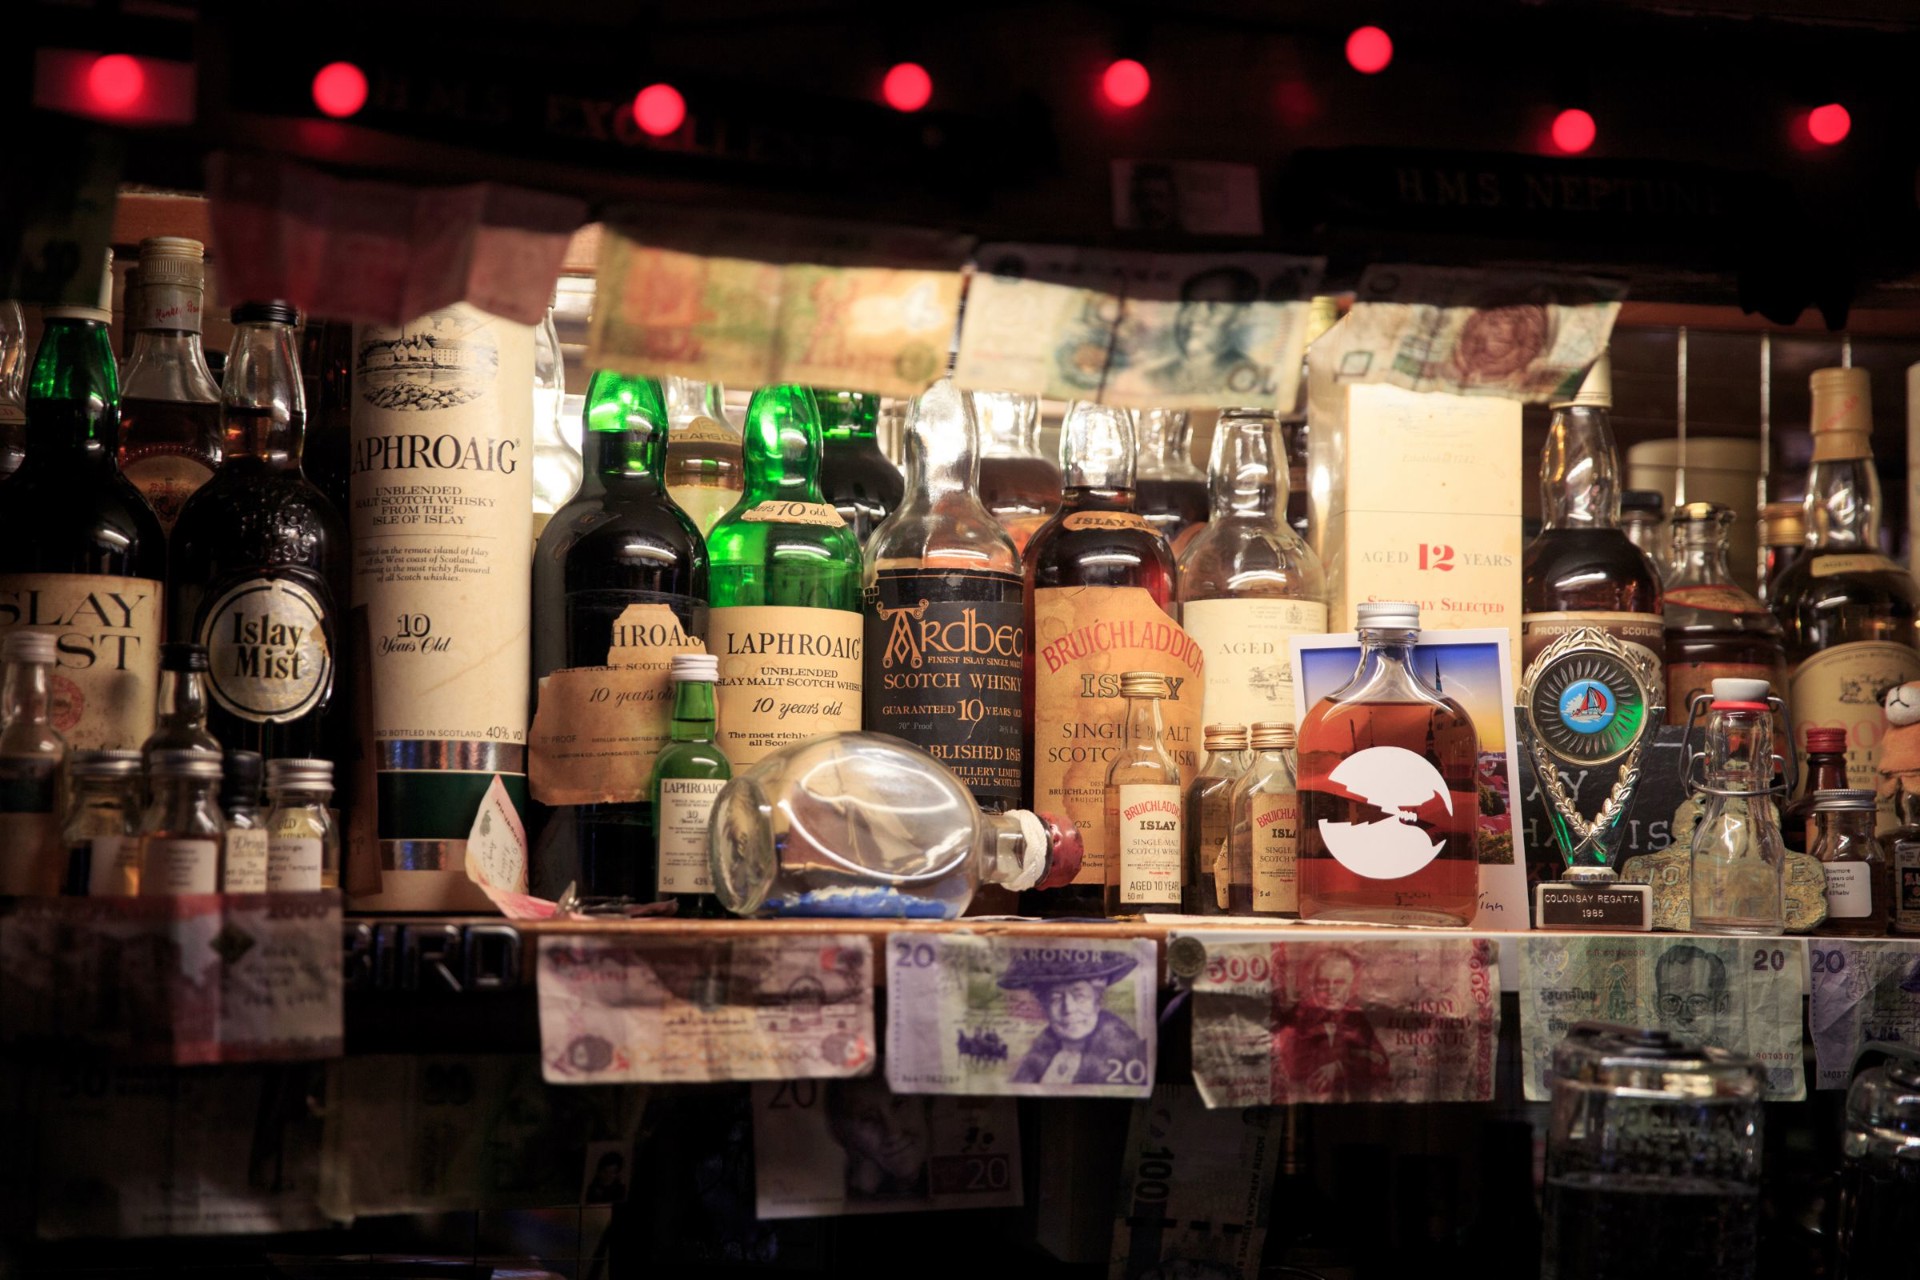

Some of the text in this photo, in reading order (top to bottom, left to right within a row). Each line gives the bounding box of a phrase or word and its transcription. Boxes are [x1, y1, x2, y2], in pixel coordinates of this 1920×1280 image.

[669, 432, 721, 441] YEARS
[375, 486, 462, 496] UNBLENDED
[381, 496, 433, 506] SCOTCH
[438, 496, 496, 507] WHISKY
[381, 505, 454, 515] FROM THE
[777, 503, 806, 516] 10
[373, 514, 466, 526] ISLE OF ISLAY
[1073, 517, 1127, 528] ISLAY
[404, 546, 432, 554] remote
[433, 546, 459, 555] island
[470, 547, 489, 557] Islay
[1361, 543, 1513, 572] AGED 12 YEARS
[385, 555, 404, 564] West
[428, 564, 451, 574] richly
[453, 564, 490, 574] flavoured
[396, 573, 421, 581] Scotch
[233, 612, 304, 649] Islay
[397, 613, 431, 638] 10
[1622, 626, 1661, 638] SCOTLAND
[376, 635, 453, 657] Years Old
[1219, 642, 1275, 655] AGED
[234, 646, 302, 680] Mist
[927, 656, 960, 664] FINEST
[963, 656, 985, 665] ISLAY
[987, 657, 1009, 667] SINGLE
[761, 667, 838, 678] UNBLENDED
[747, 677, 785, 687] MALT
[786, 677, 835, 688] SCOTCH
[884, 673, 1022, 692] SCOTCH WHISKY
[589, 687, 610, 703] 10
[615, 689, 654, 708] years
[752, 697, 843, 720] 10 years old
[882, 705, 956, 715] GUARANTEED
[957, 699, 984, 722] 10
[985, 706, 1012, 718] YEARS
[389, 729, 424, 737] BOTTLED
[438, 730, 482, 738] SCOTLAND
[485, 726, 510, 740] 40%
[1140, 821, 1176, 831] ISLAY
[1126, 848, 1160, 856] SCOTCH
[1260, 855, 1290, 863] SCOTCH
[1129, 881, 1152, 891] AGED
[1154, 881, 1163, 891] 10
[1545, 894, 1640, 904] COLONSAY REGATTA
[1582, 908, 1605, 918] 1985
[896, 943, 935, 968] 20
[1754, 949, 1785, 971] 20
[1812, 950, 1846, 974] 20
[1106, 1058, 1147, 1085] 20
[965, 1156, 1009, 1190] 20
